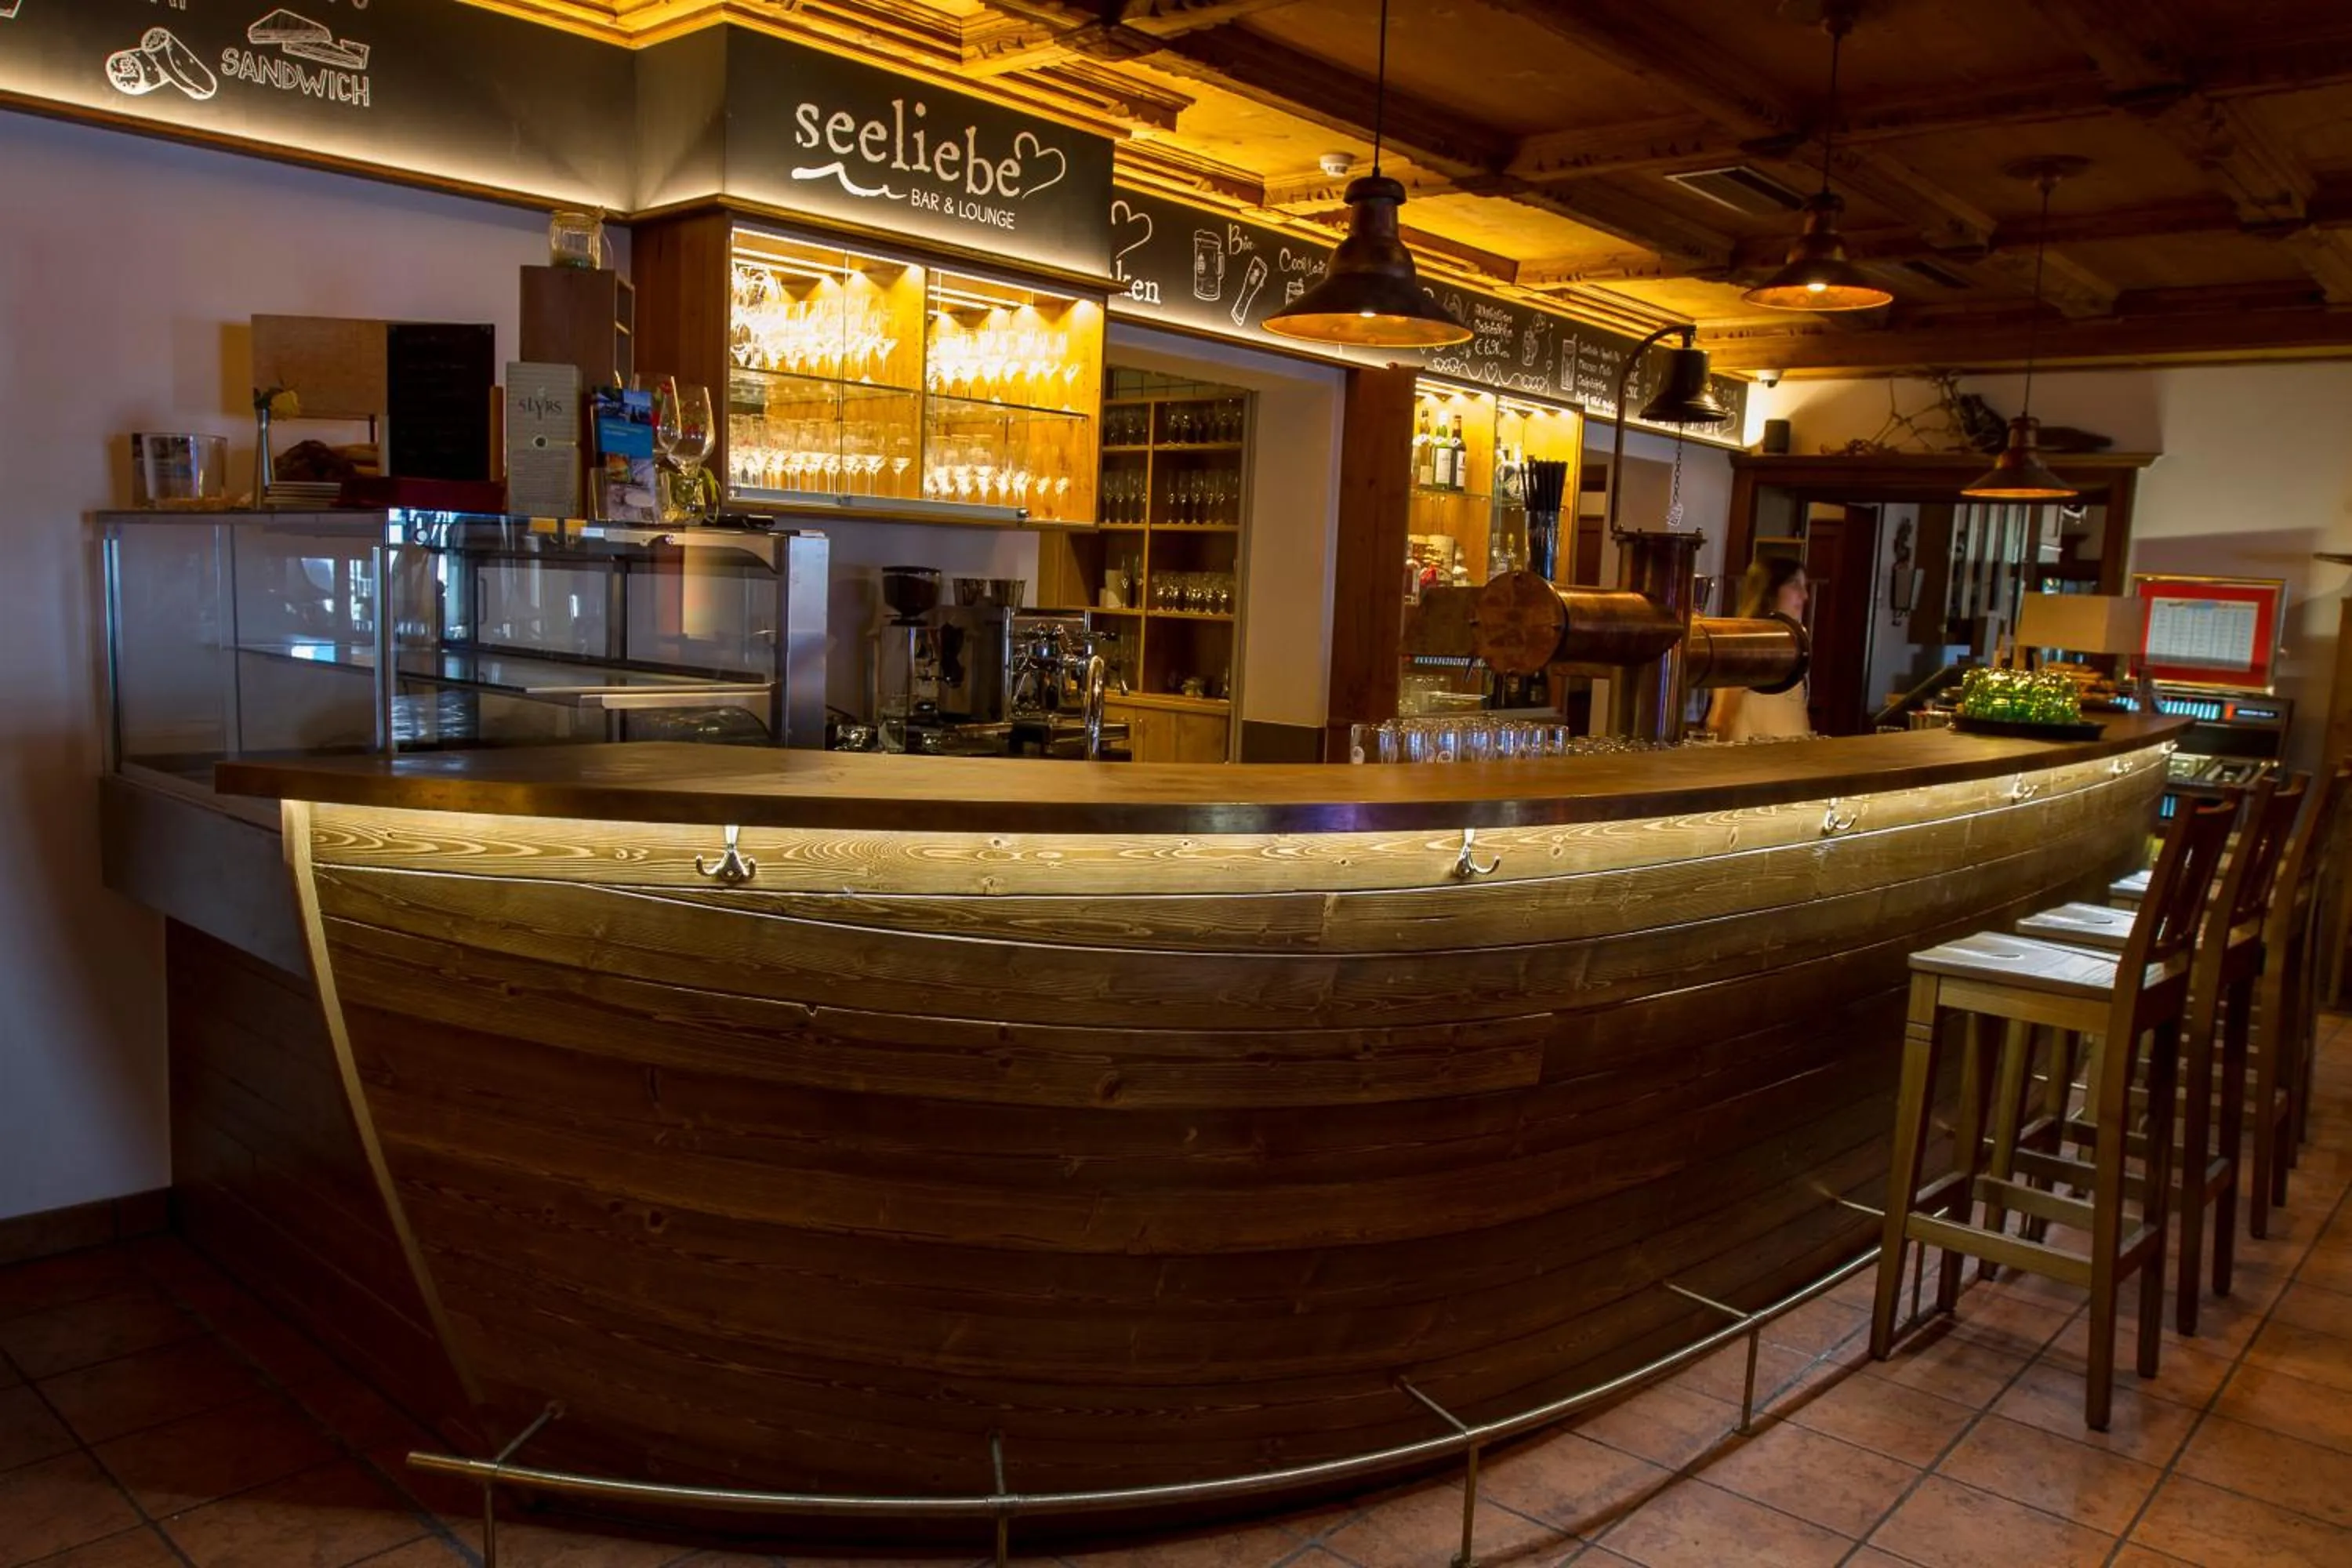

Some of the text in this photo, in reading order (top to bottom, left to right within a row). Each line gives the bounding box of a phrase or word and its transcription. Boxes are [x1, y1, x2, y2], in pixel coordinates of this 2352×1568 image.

[221, 47, 370, 107] SANDWICH
[795, 99, 1020, 198] seeliebe
[911, 187, 1016, 230] BAR & LOUNGE
